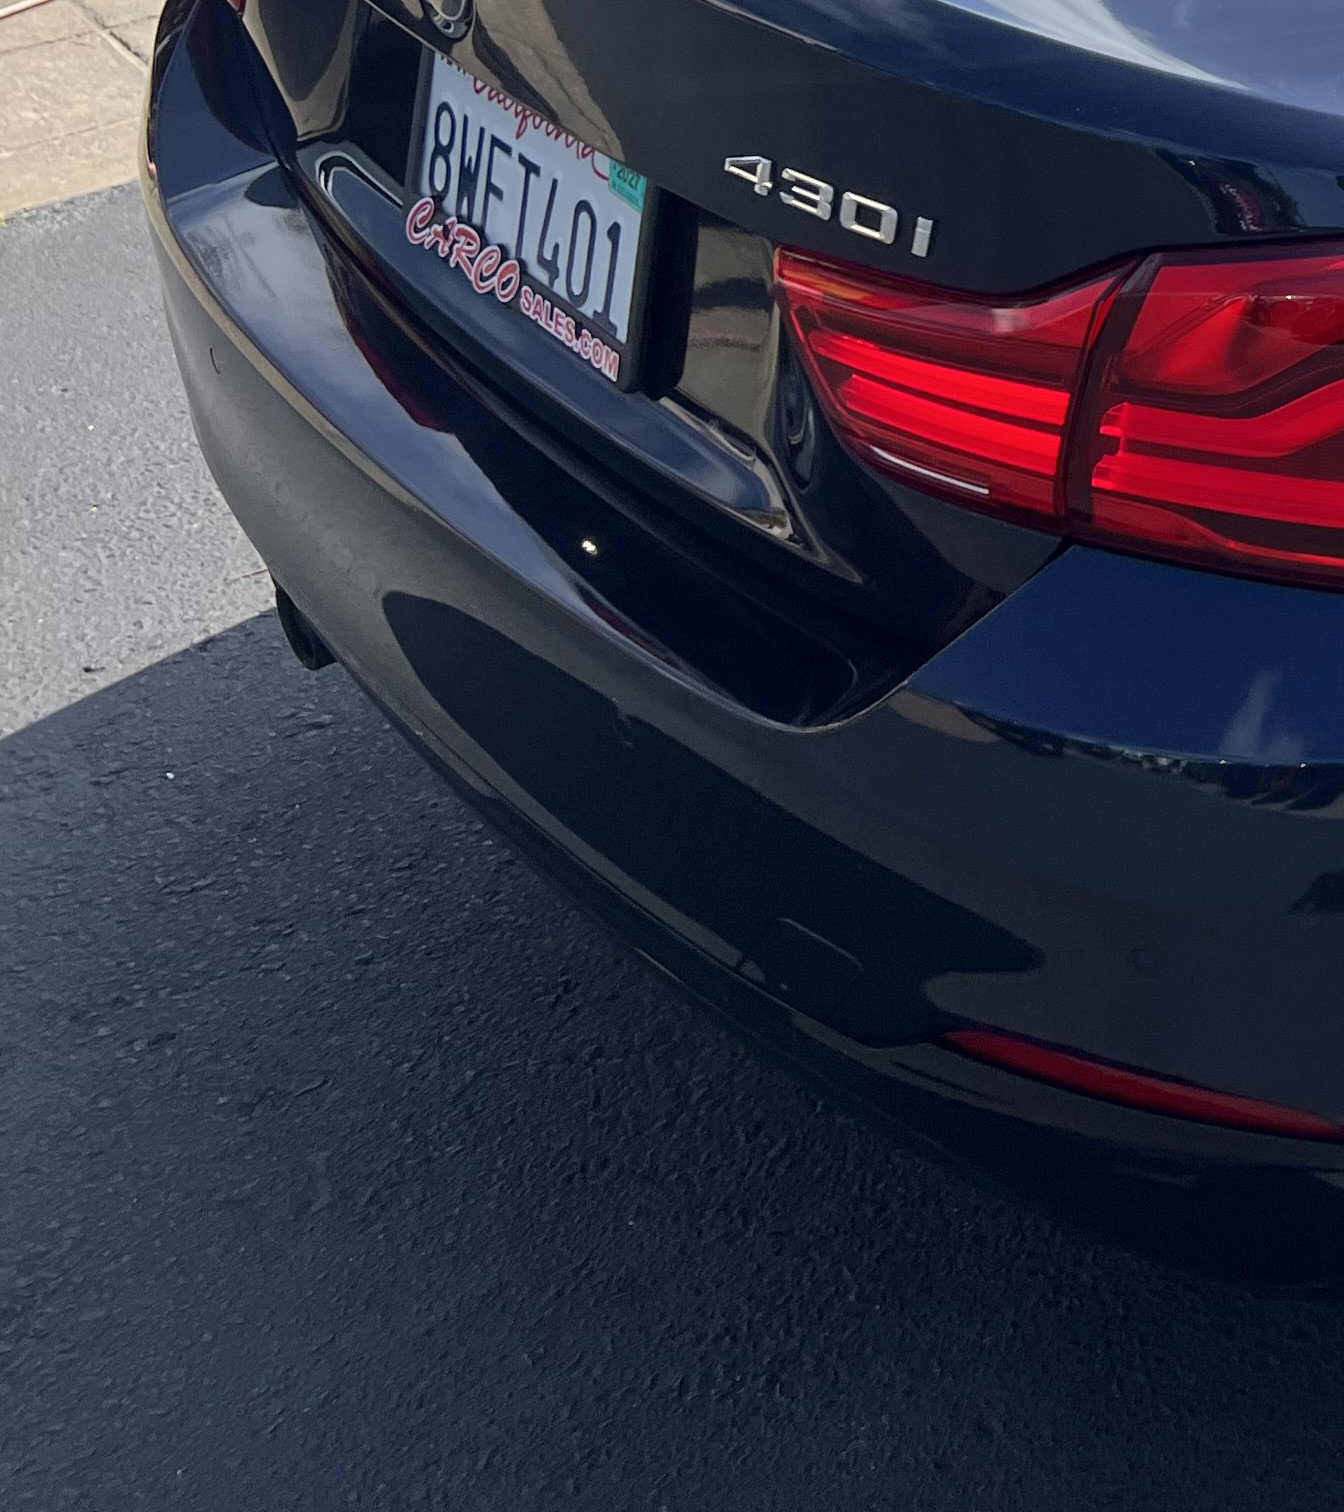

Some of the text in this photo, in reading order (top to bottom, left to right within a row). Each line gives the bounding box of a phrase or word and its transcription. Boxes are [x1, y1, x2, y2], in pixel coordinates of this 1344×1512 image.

[405, 197, 621, 382] CARCO SALES.COM
[429, 101, 622, 339] 8WFT401
